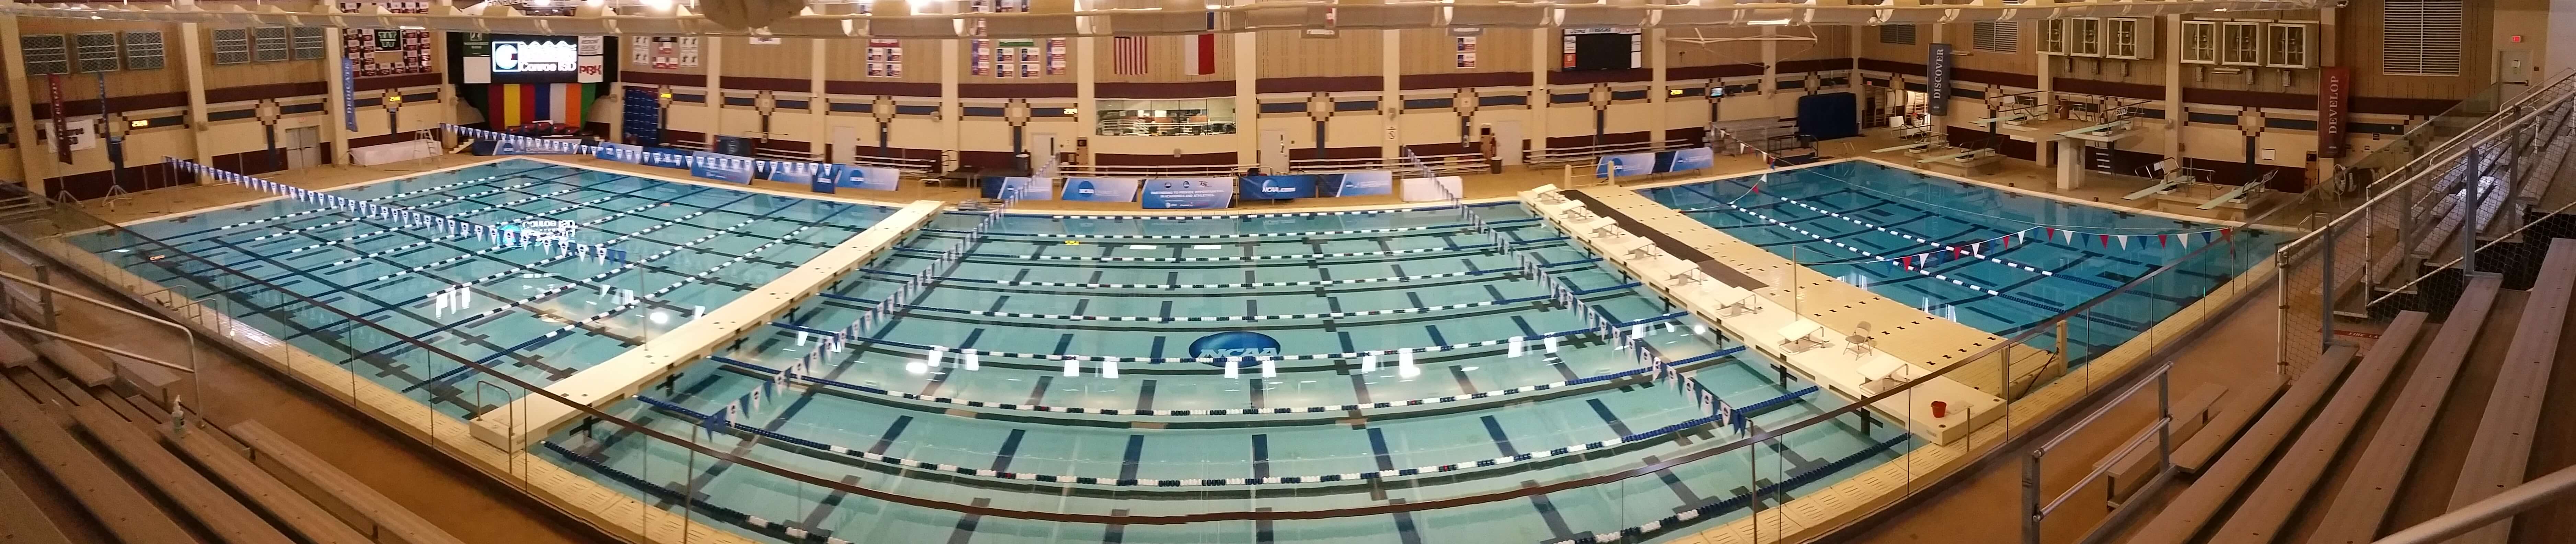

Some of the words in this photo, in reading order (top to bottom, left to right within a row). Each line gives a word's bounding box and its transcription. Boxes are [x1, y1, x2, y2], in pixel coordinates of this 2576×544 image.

[521, 63, 556, 71] Conroe
[558, 62, 577, 71] ISD
[579, 65, 602, 75] PBK
[1933, 48, 1944, 99] DISCOVER
[2328, 76, 2339, 134] DEVELOP
[1198, 347, 1277, 358] NCAA
